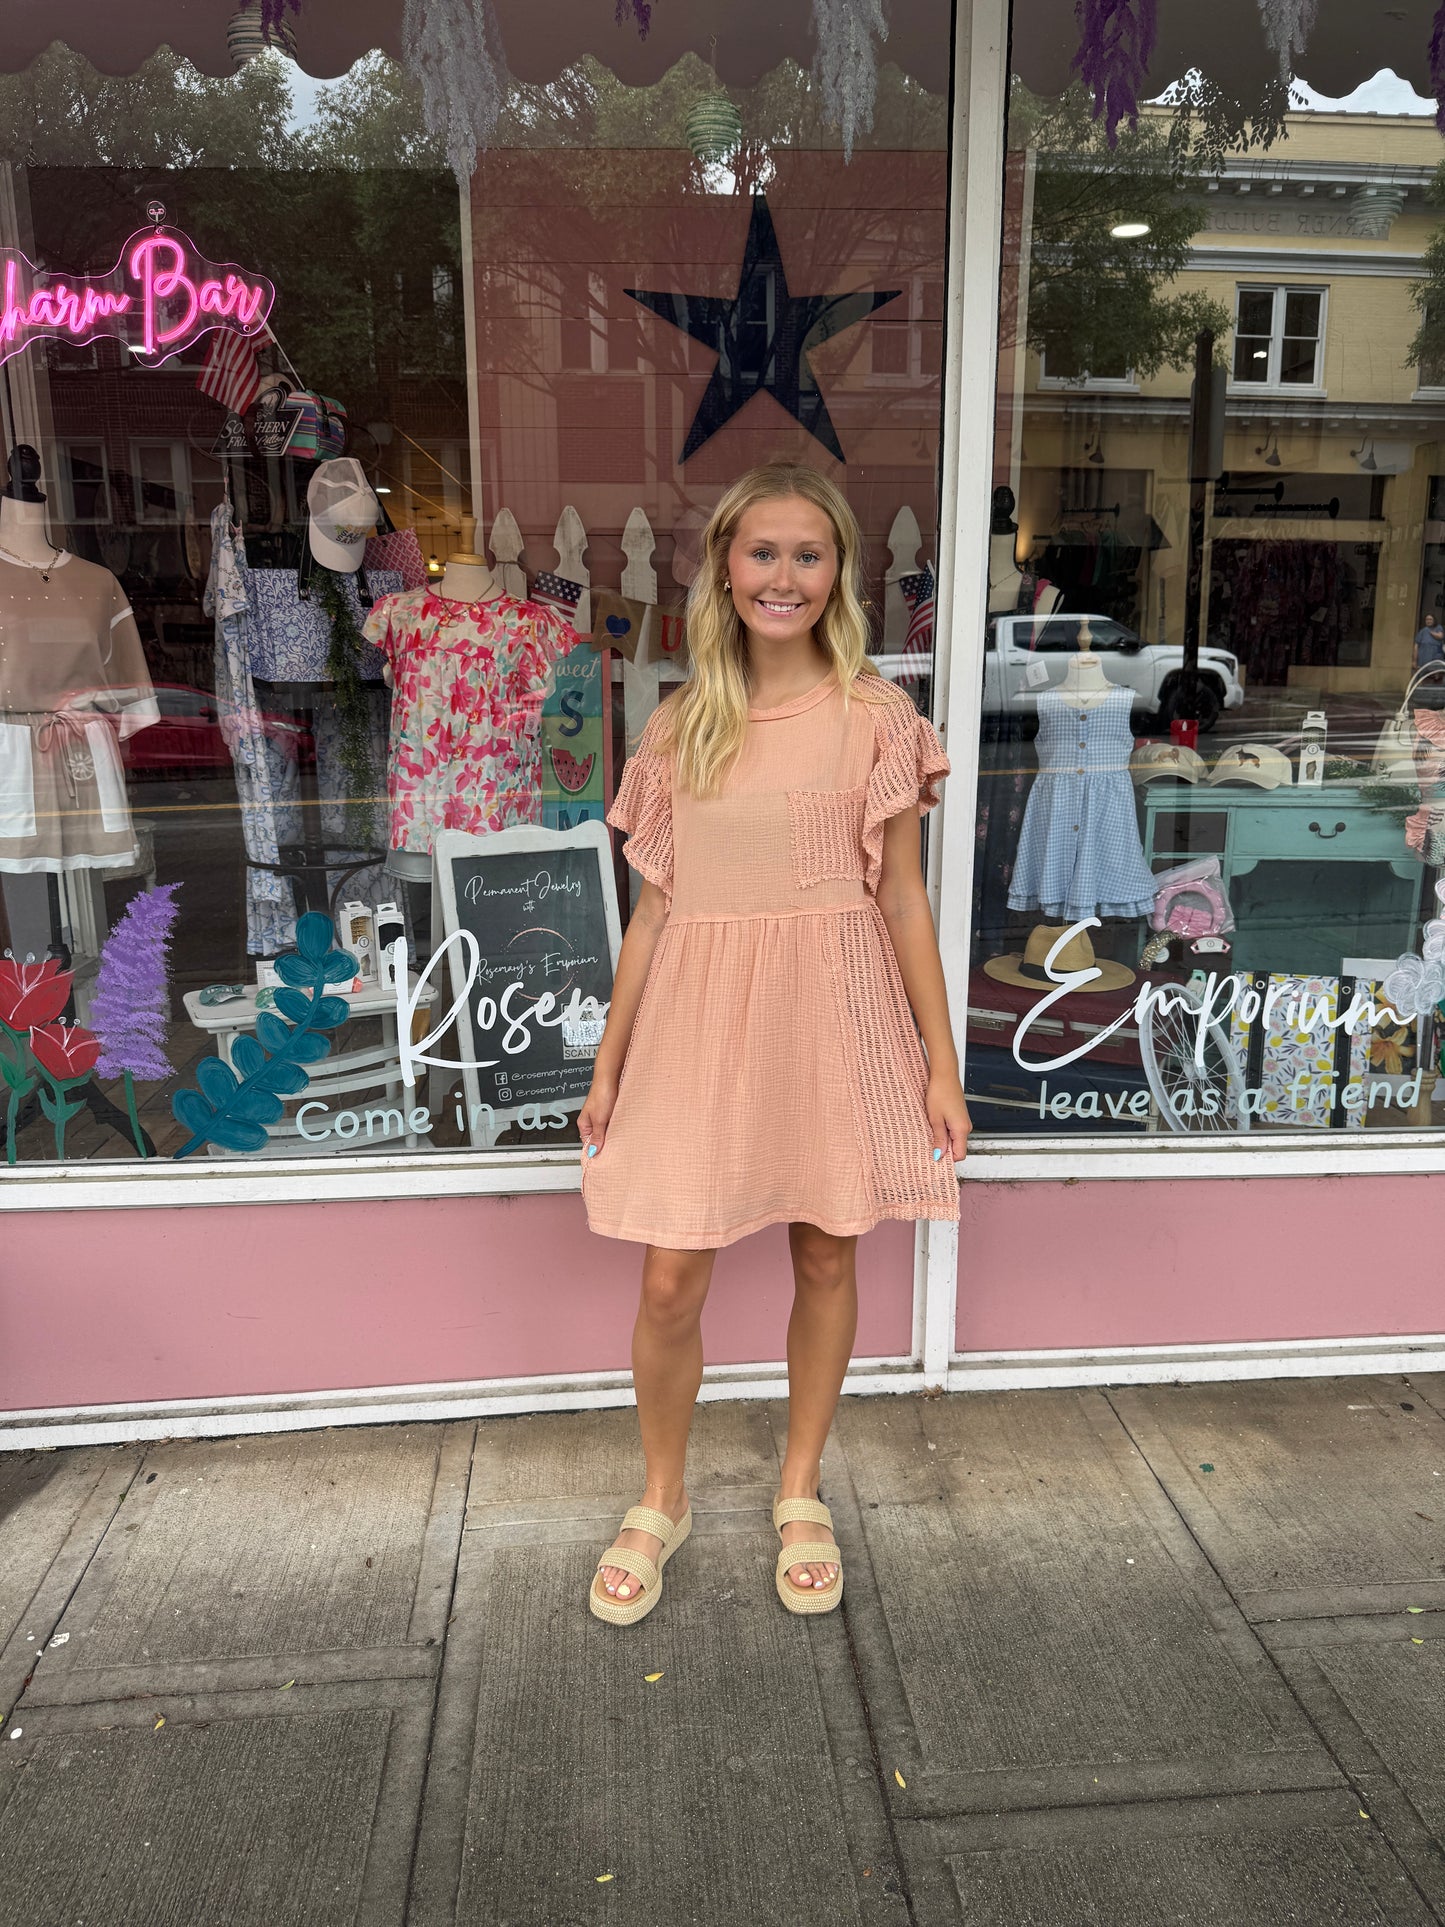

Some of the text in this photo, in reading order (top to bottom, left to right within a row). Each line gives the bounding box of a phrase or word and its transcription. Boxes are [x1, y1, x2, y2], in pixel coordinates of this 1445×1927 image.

[0, 236, 265, 355] harm Bar
[220, 419, 290, 439] SOTHERN
[661, 614, 684, 652] U
[556, 656, 600, 678] weet
[558, 690, 584, 737] S
[464, 870, 583, 905] Permanent Jewelry
[522, 900, 536, 913] with
[476, 952, 599, 986] Rosemary's Emporium
[394, 916, 1418, 1087] Rosem Emporium
[564, 1049, 591, 1058] SCAN
[511, 1064, 595, 1081] @rosemarysempor
[1039, 1068, 1423, 1120] leave as a friend
[295, 1091, 569, 1142] Come in as
